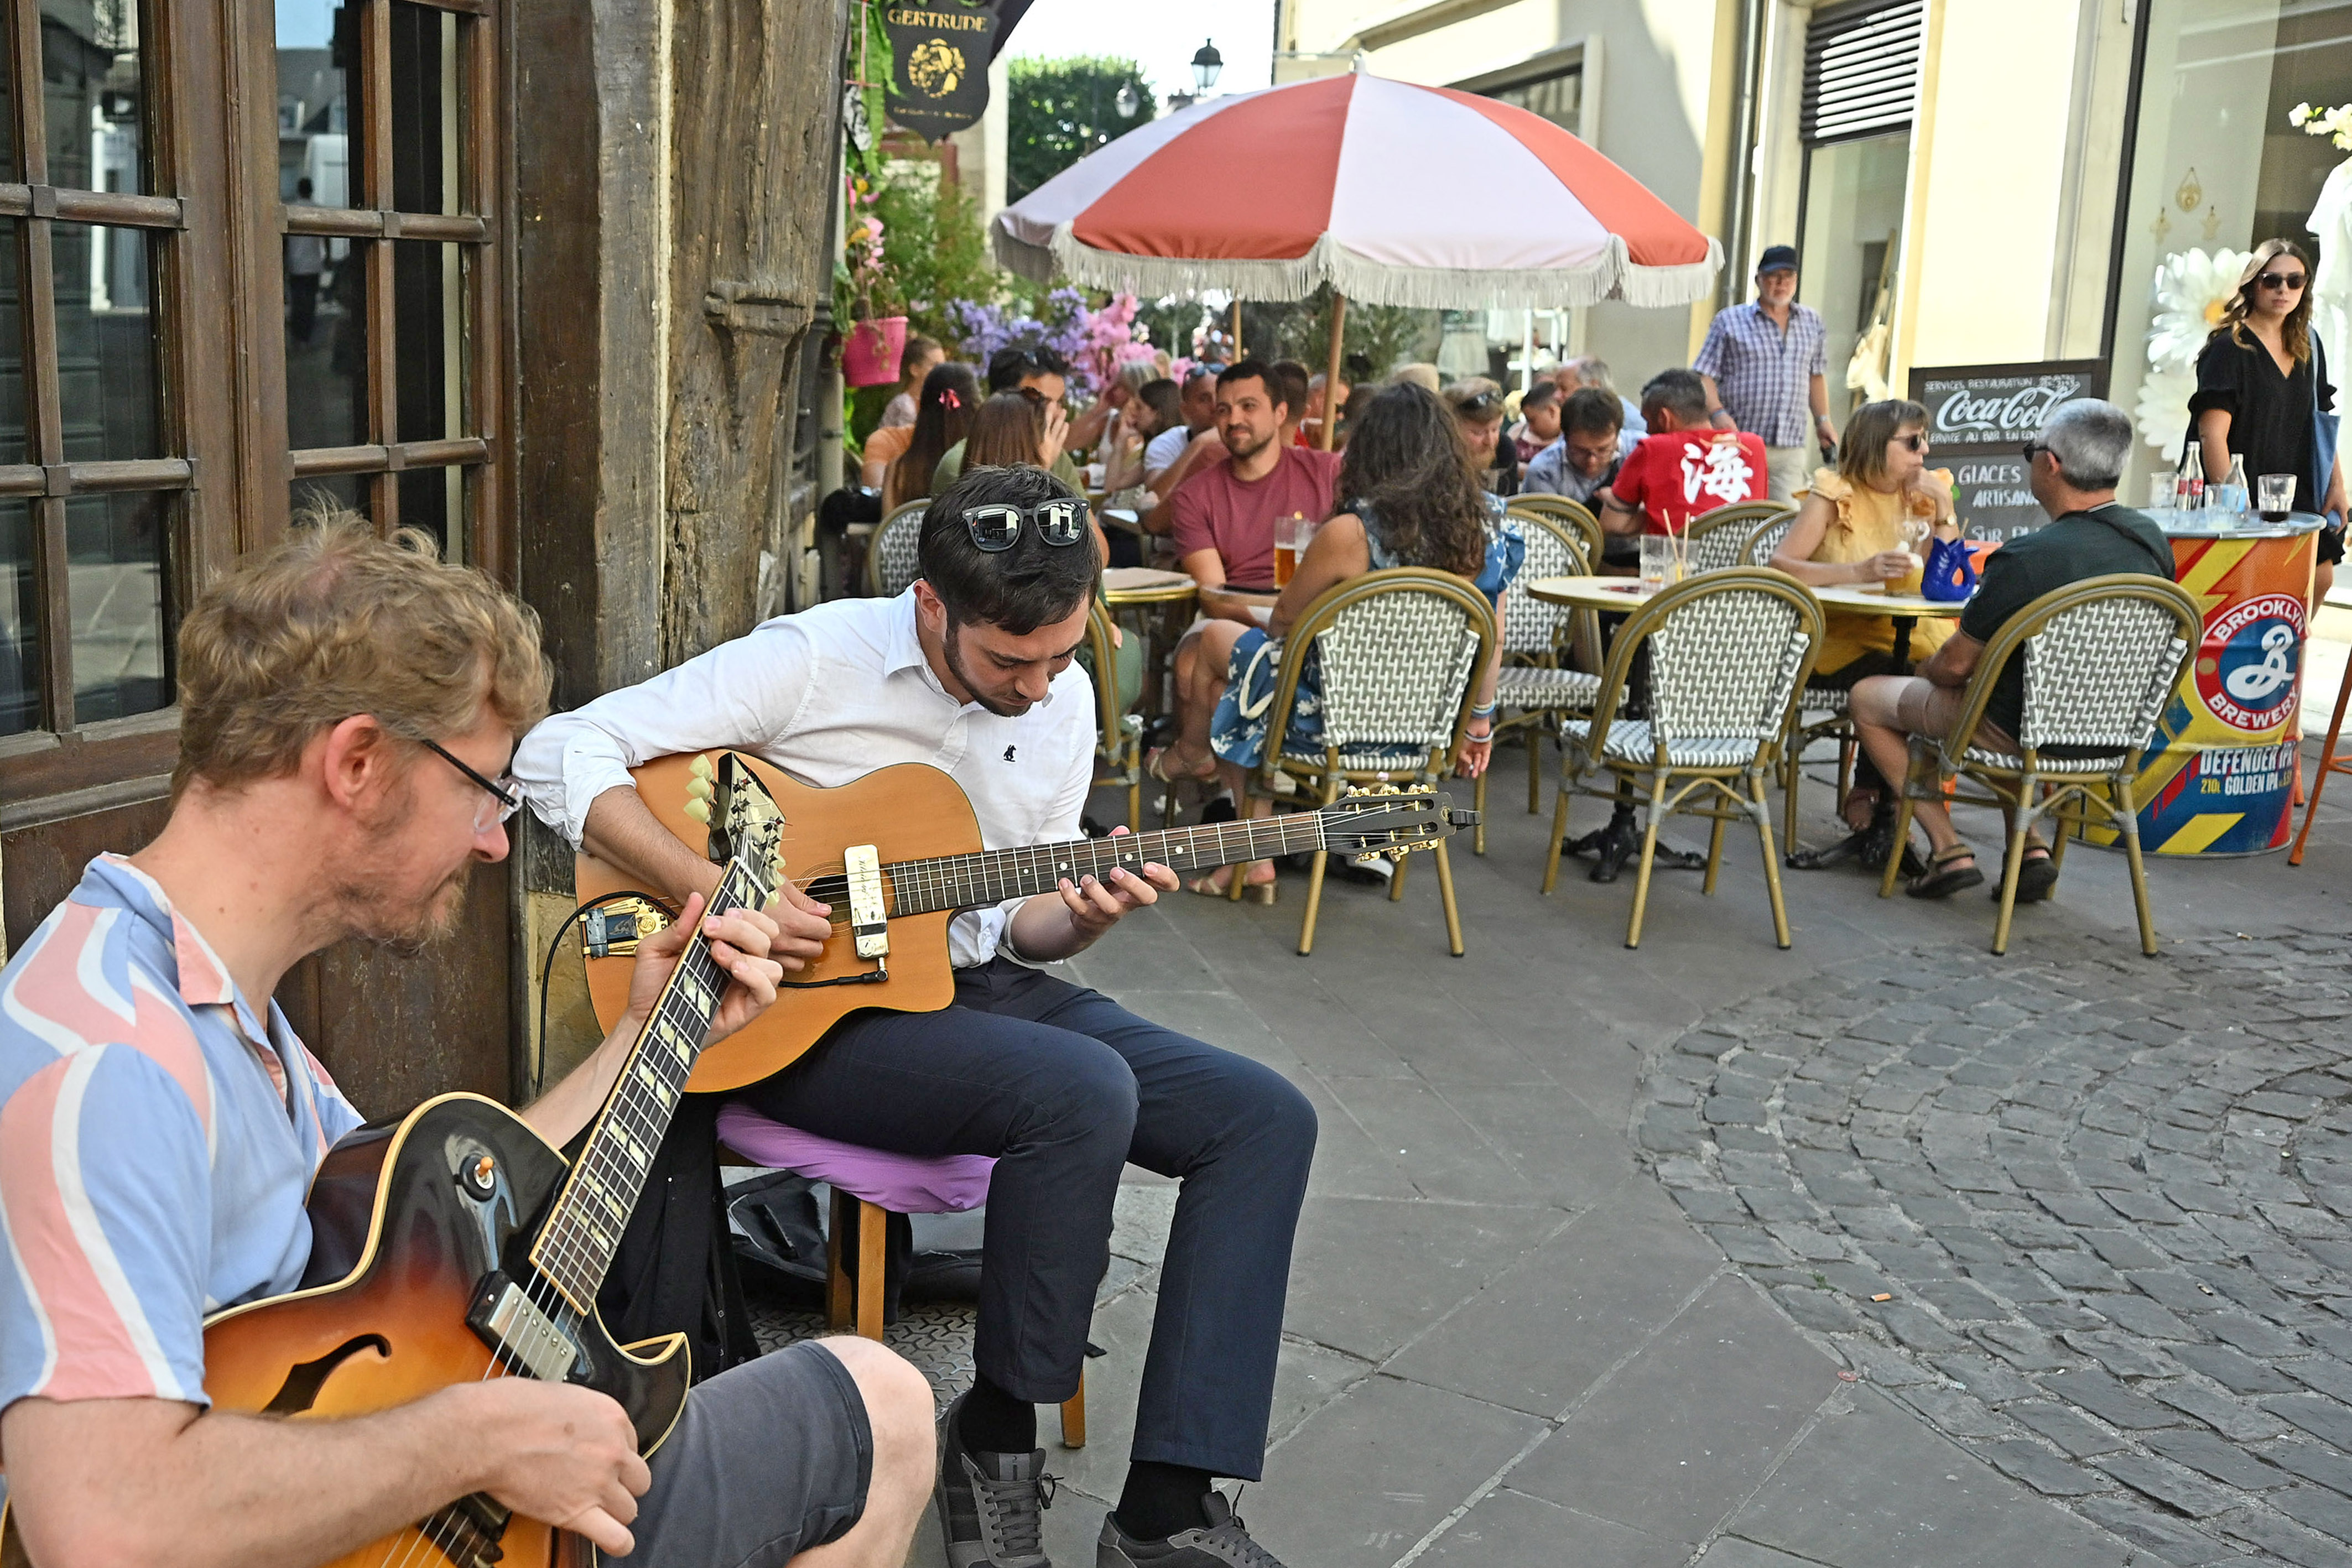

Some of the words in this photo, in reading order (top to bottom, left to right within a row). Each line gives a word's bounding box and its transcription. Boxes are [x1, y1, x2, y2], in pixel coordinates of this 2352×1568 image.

[888, 9, 987, 32] GERTRUDE
[1937, 381, 2080, 432] Coca-Col
[1929, 431, 1961, 445] ERVICE
[1680, 442, 1753, 504] 海
[1958, 465, 2022, 485] GLACES
[2214, 599, 2305, 642] BROOKLYN
[2208, 685, 2297, 728] BREWERY
[2199, 745, 2280, 775] DEFENDER
[2225, 772, 2265, 796] GOLDEN
[2266, 771, 2278, 793] IPA
